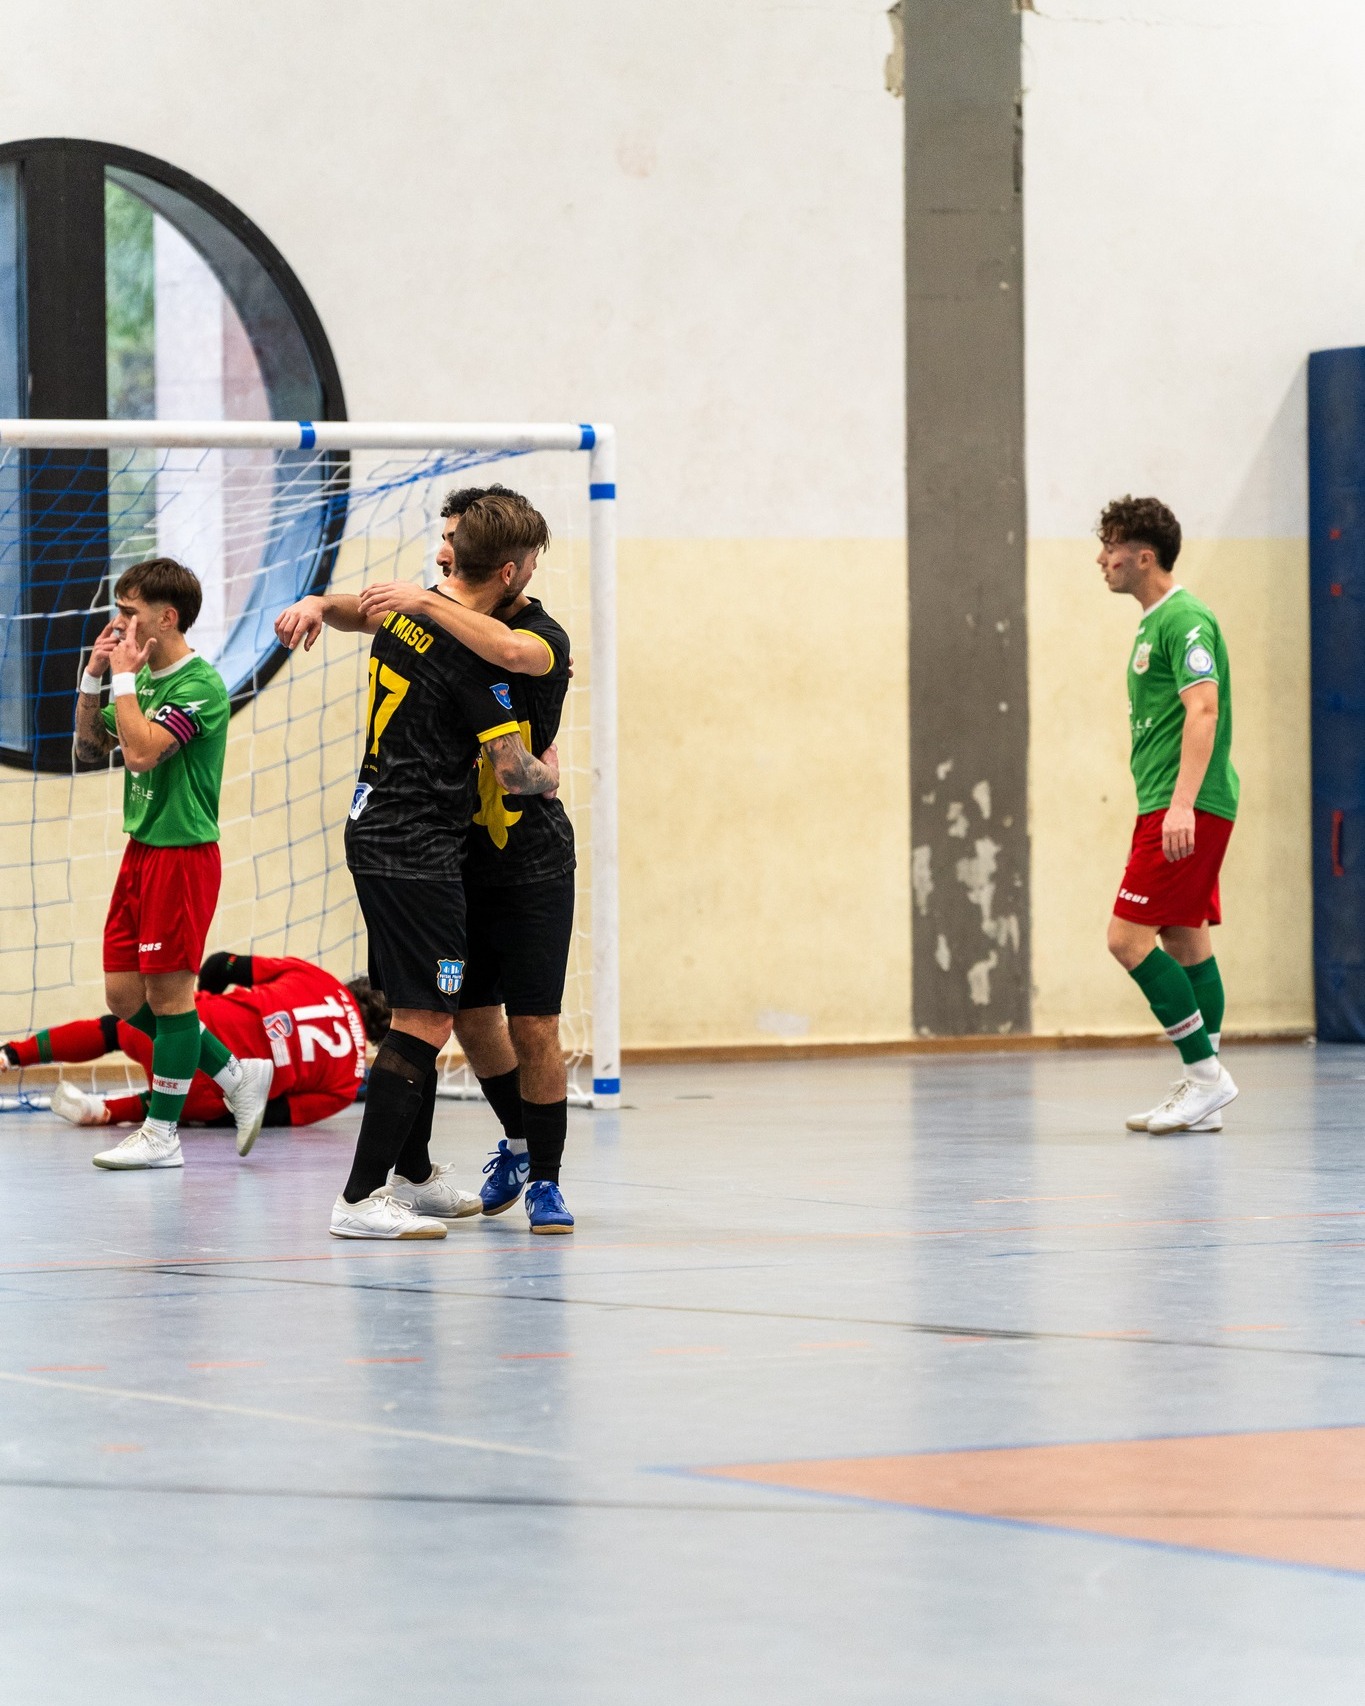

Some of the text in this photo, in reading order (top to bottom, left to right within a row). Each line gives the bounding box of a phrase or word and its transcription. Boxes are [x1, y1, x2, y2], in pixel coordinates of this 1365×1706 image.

[390, 614, 434, 654] MASO
[155, 704, 172, 721] C
[1118, 887, 1150, 905] Zeus
[292, 995, 352, 1062] 12
